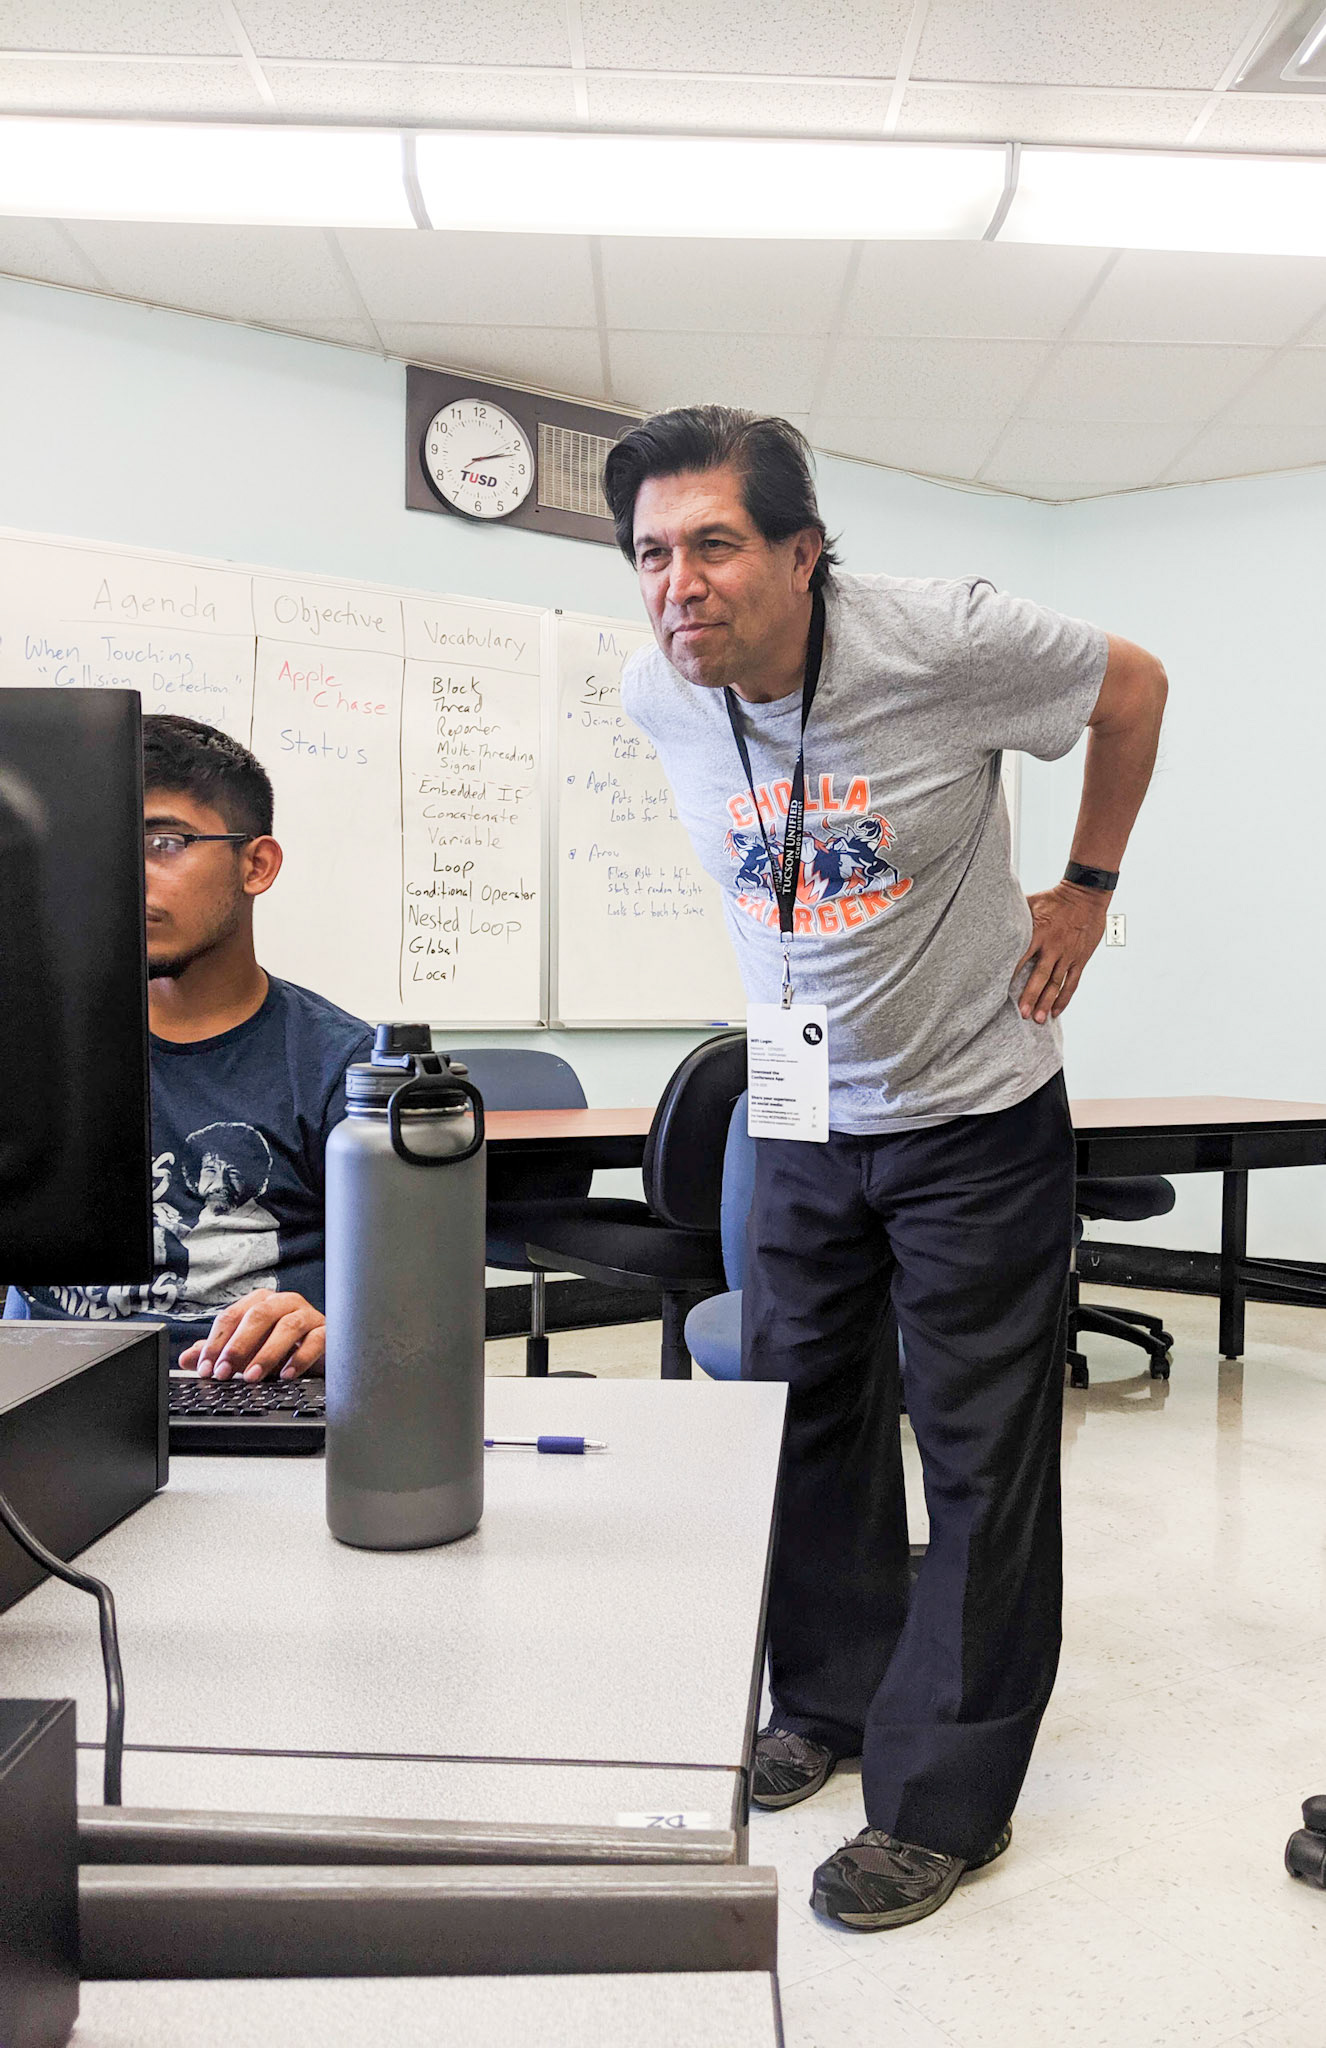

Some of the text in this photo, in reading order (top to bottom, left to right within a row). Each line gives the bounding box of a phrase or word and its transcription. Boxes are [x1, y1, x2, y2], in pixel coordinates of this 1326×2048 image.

[451, 408, 462, 420] 11
[473, 407, 487, 419] 12
[435, 422, 448, 433] 10
[431, 444, 439, 454] 9
[514, 440, 521, 451] 2
[436, 470, 444, 481] 8
[461, 470, 497, 488] TUSD
[518, 464, 526, 475] 3
[452, 491, 460, 502] 7
[512, 486, 519, 497] 4
[474, 501, 482, 512] 6
[496, 501, 504, 512] 5
[93, 578, 216, 622] Agenda
[274, 595, 386, 635] Objective
[424, 620, 526, 661] Vocabulary
[25, 635, 194, 673] When Touching
[278, 660, 342, 691] Apple
[432, 676, 482, 694] Block
[313, 691, 388, 715] Chase
[433, 694, 482, 713] Thread
[437, 716, 501, 742] Reporter
[280, 729, 368, 765] Status
[440, 757, 481, 774] Signal
[418, 780, 486, 801] Embedded
[587, 771, 620, 794] Apple
[726, 773, 871, 829] CHOLLA
[422, 804, 519, 825] Concatenate
[428, 826, 504, 849] Variable
[782, 799, 798, 895] TUCSON UNIFIED
[433, 852, 475, 879] Loop
[406, 877, 536, 905] Conditional Operator
[408, 904, 522, 944] Nested Loop
[409, 936, 459, 955] Global
[412, 962, 456, 983] Local
